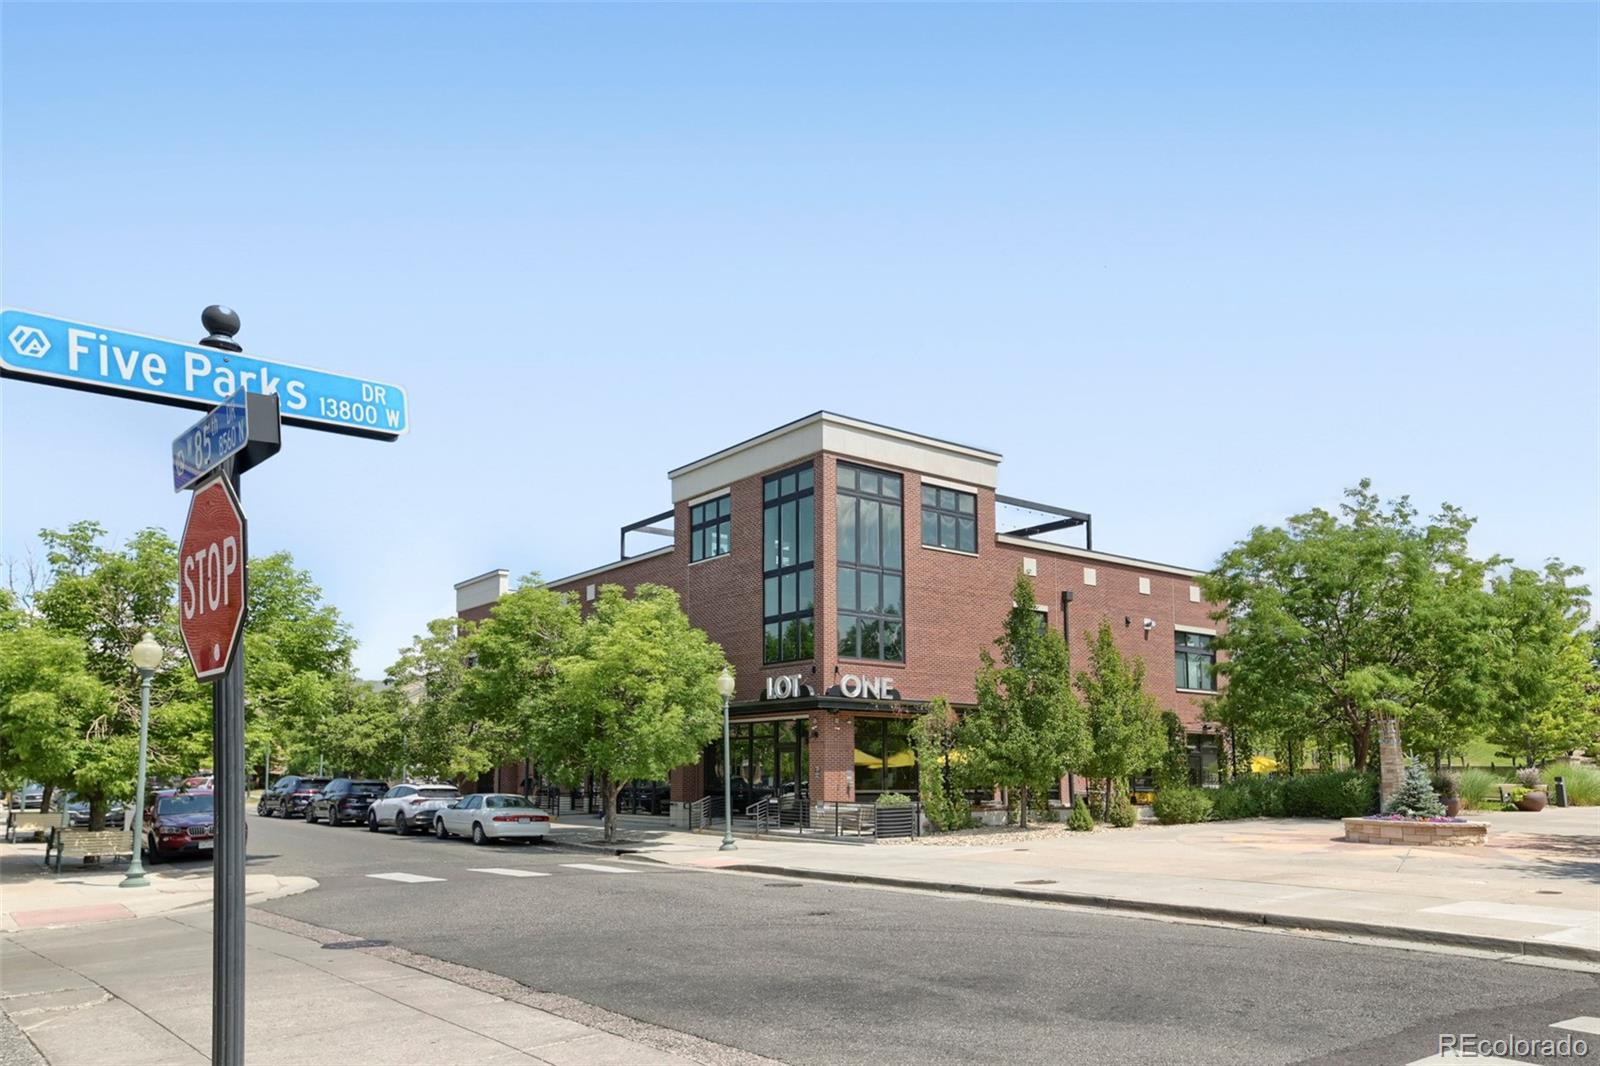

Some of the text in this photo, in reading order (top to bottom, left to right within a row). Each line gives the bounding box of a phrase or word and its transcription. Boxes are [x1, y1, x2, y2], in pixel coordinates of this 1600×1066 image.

[67, 327, 308, 410] Five Parks
[361, 383, 386, 406] DR
[319, 396, 400, 428] 13800 W
[184, 535, 238, 620] STOP
[766, 673, 894, 700] LOT ONE
